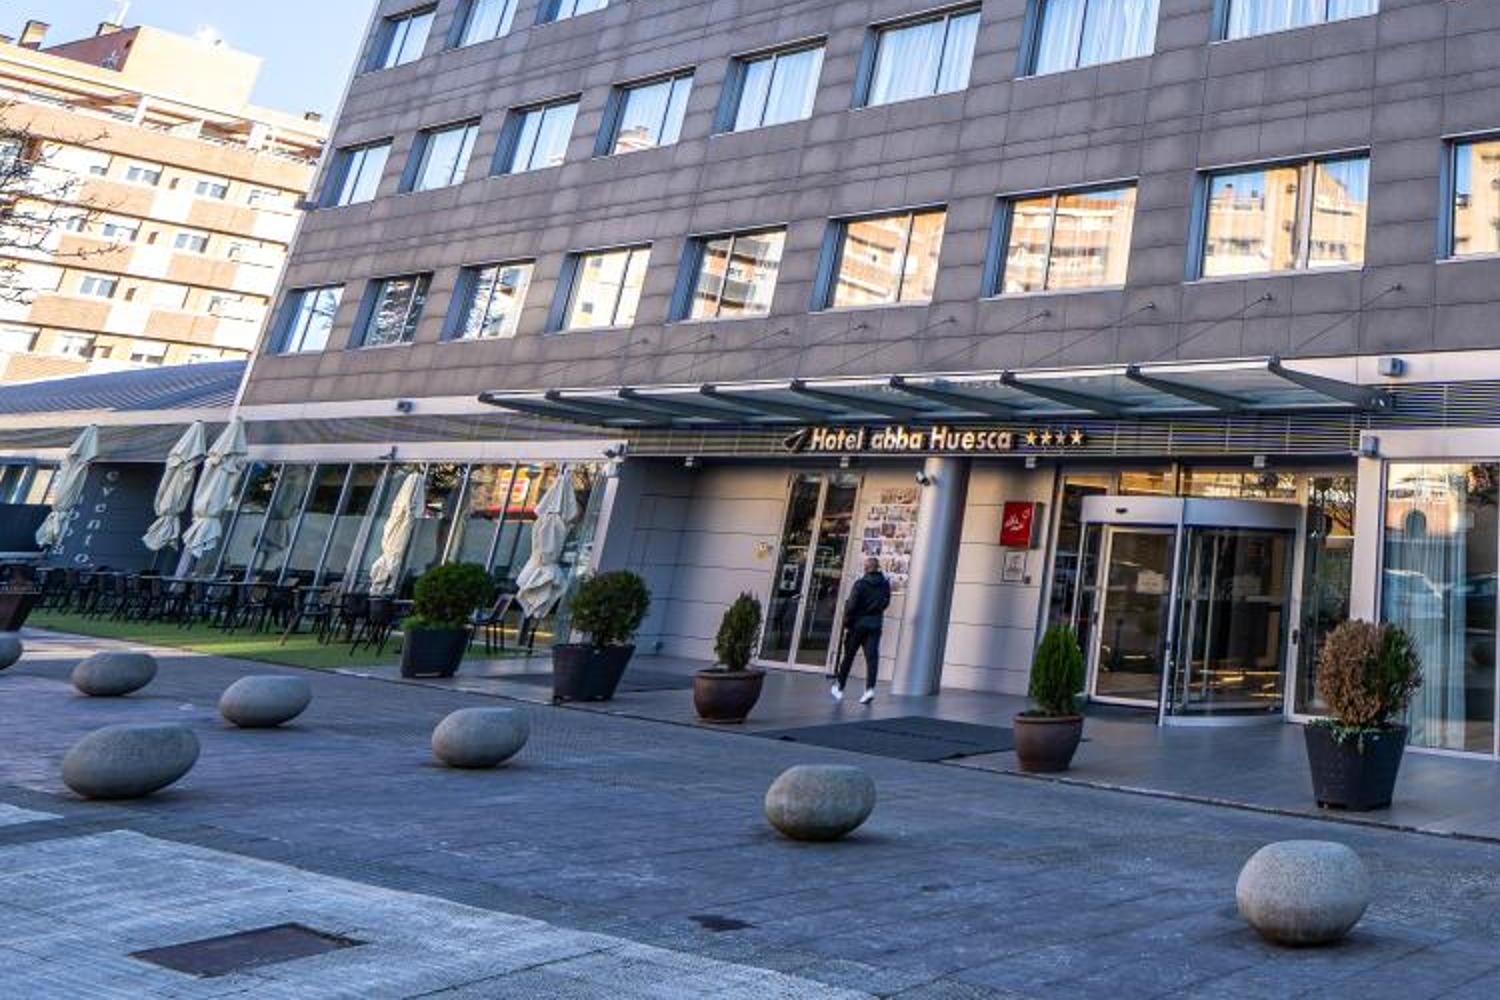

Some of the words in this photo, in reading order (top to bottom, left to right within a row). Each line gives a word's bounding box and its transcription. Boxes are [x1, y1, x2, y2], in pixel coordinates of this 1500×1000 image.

[809, 426, 863, 450] Hotel
[870, 426, 923, 450] abba
[929, 425, 1012, 450] Huesca
